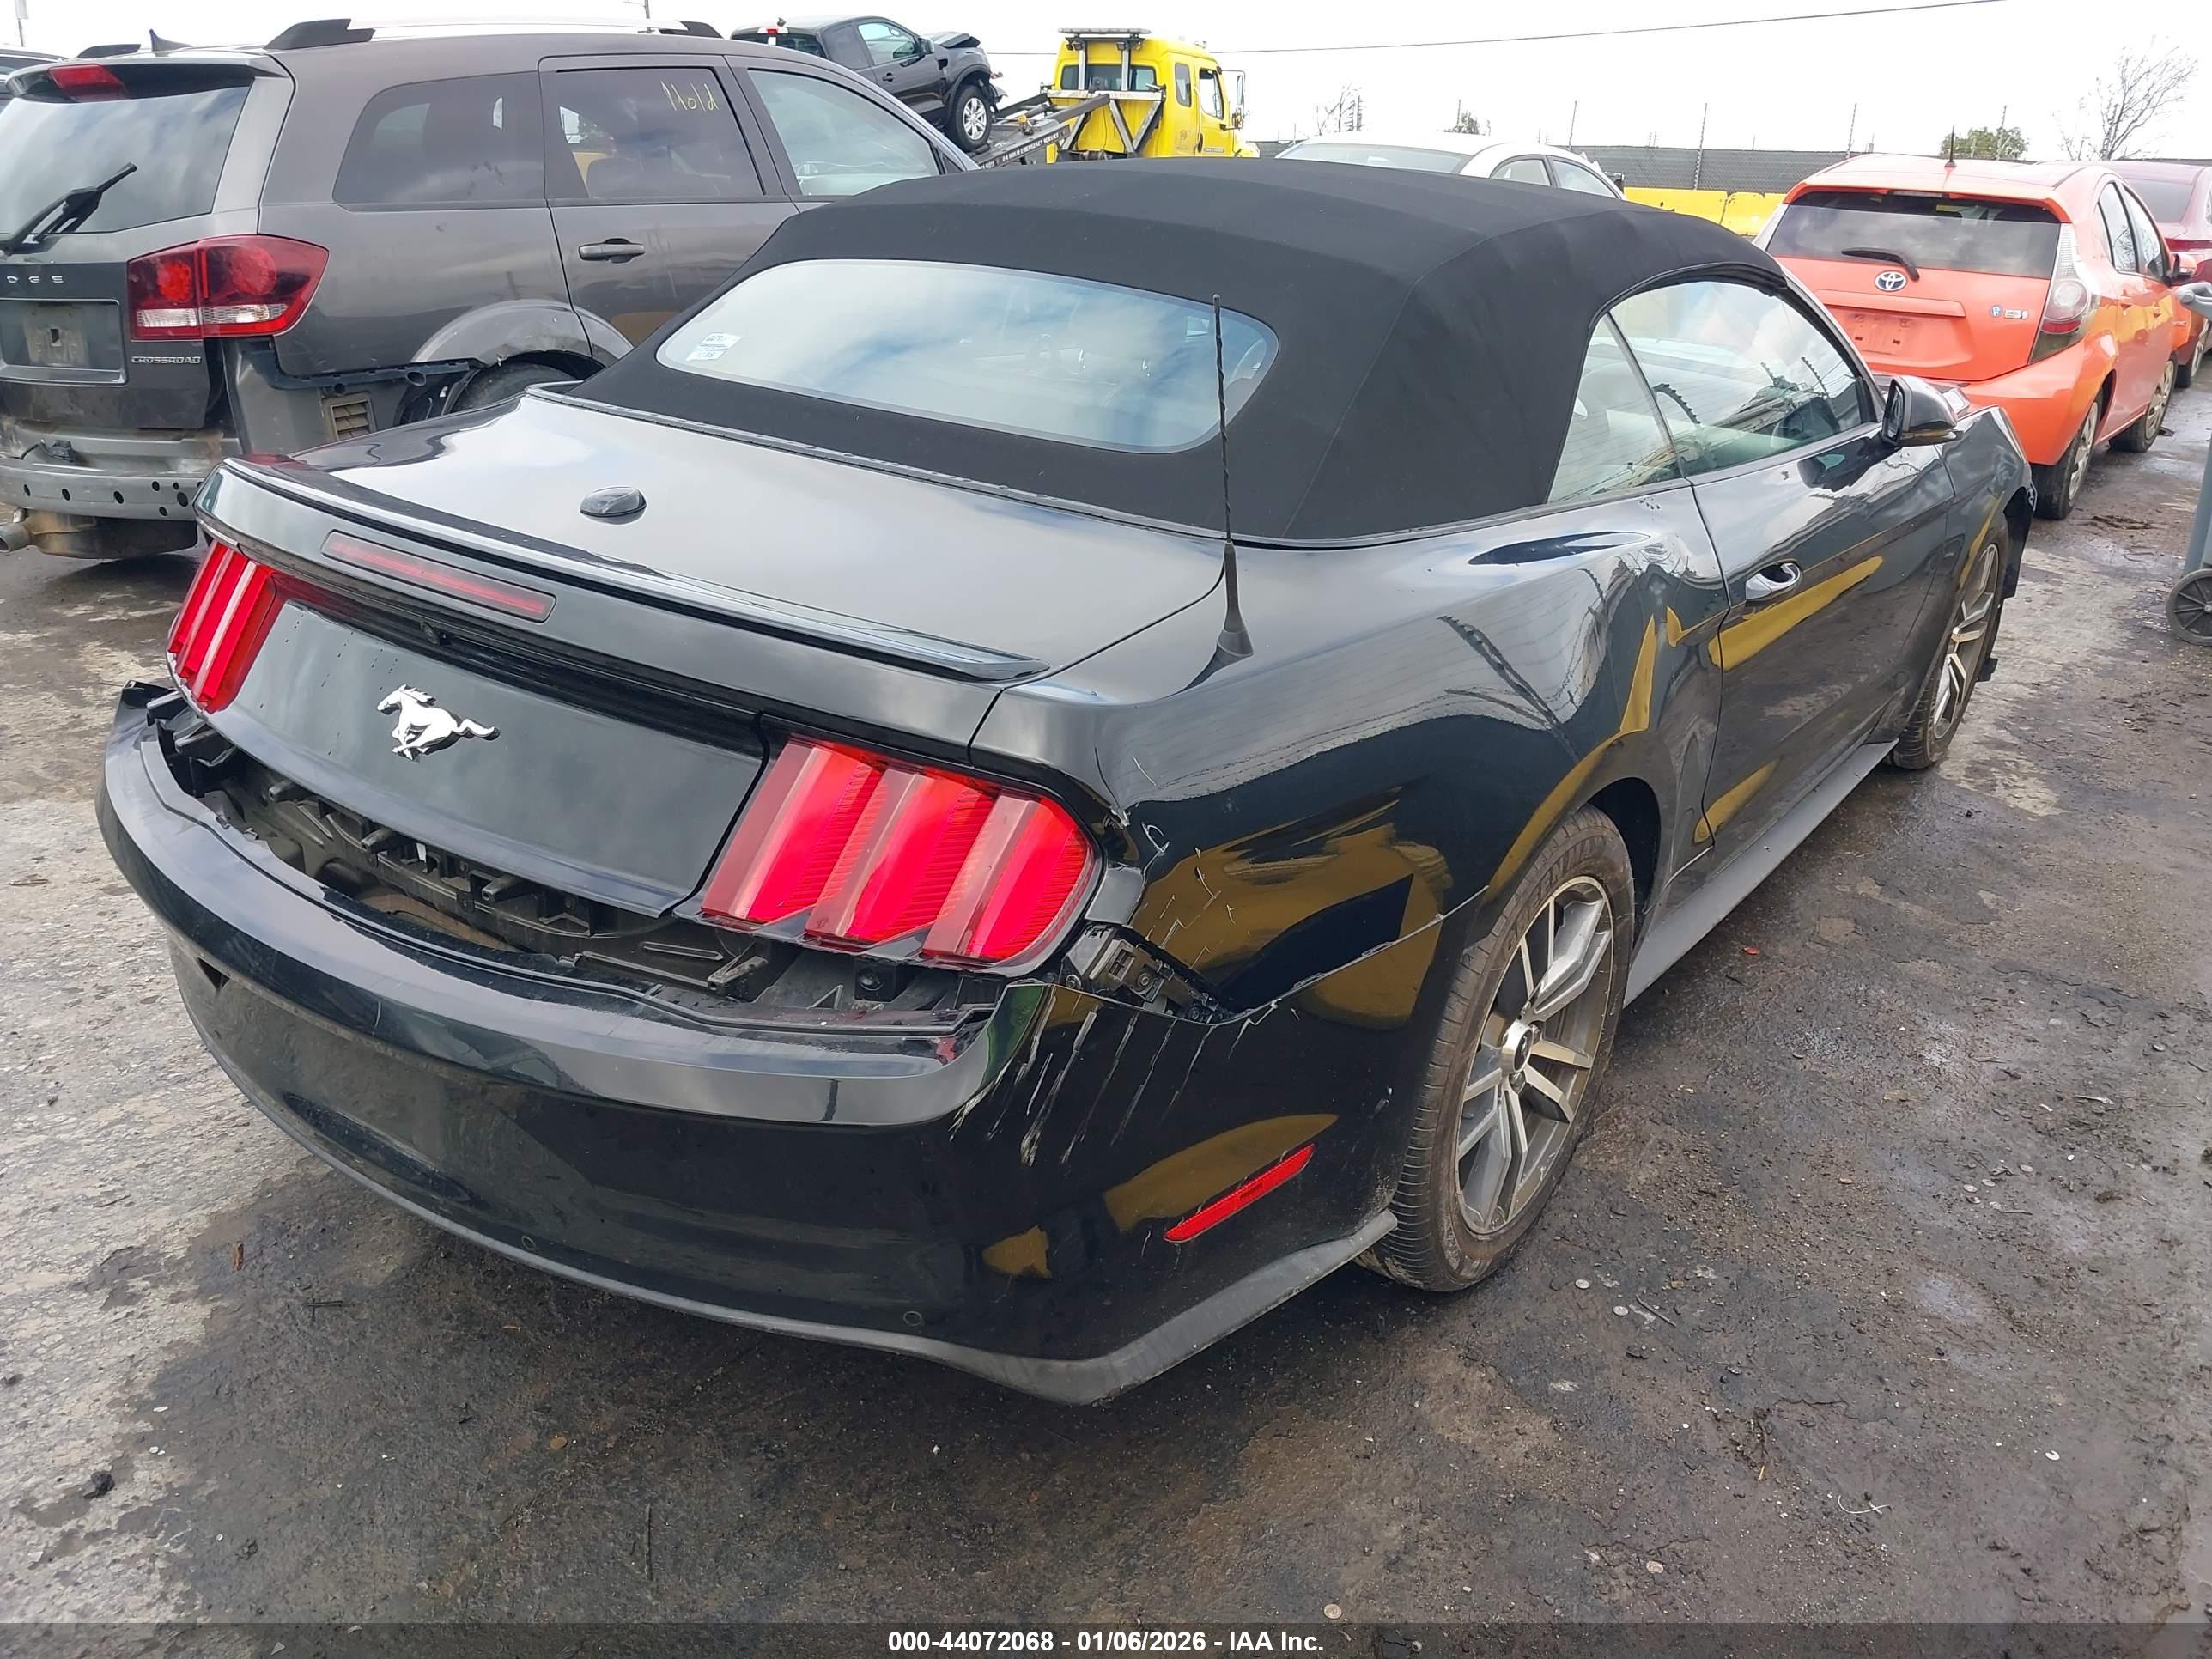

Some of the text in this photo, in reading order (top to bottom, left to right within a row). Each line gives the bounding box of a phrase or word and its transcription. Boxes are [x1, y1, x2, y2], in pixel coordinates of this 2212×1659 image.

[1020, 139, 1043, 155] EMERGENCY
[1043, 132, 1059, 144] SERVICE
[131, 356, 201, 364] CROSSROAD
